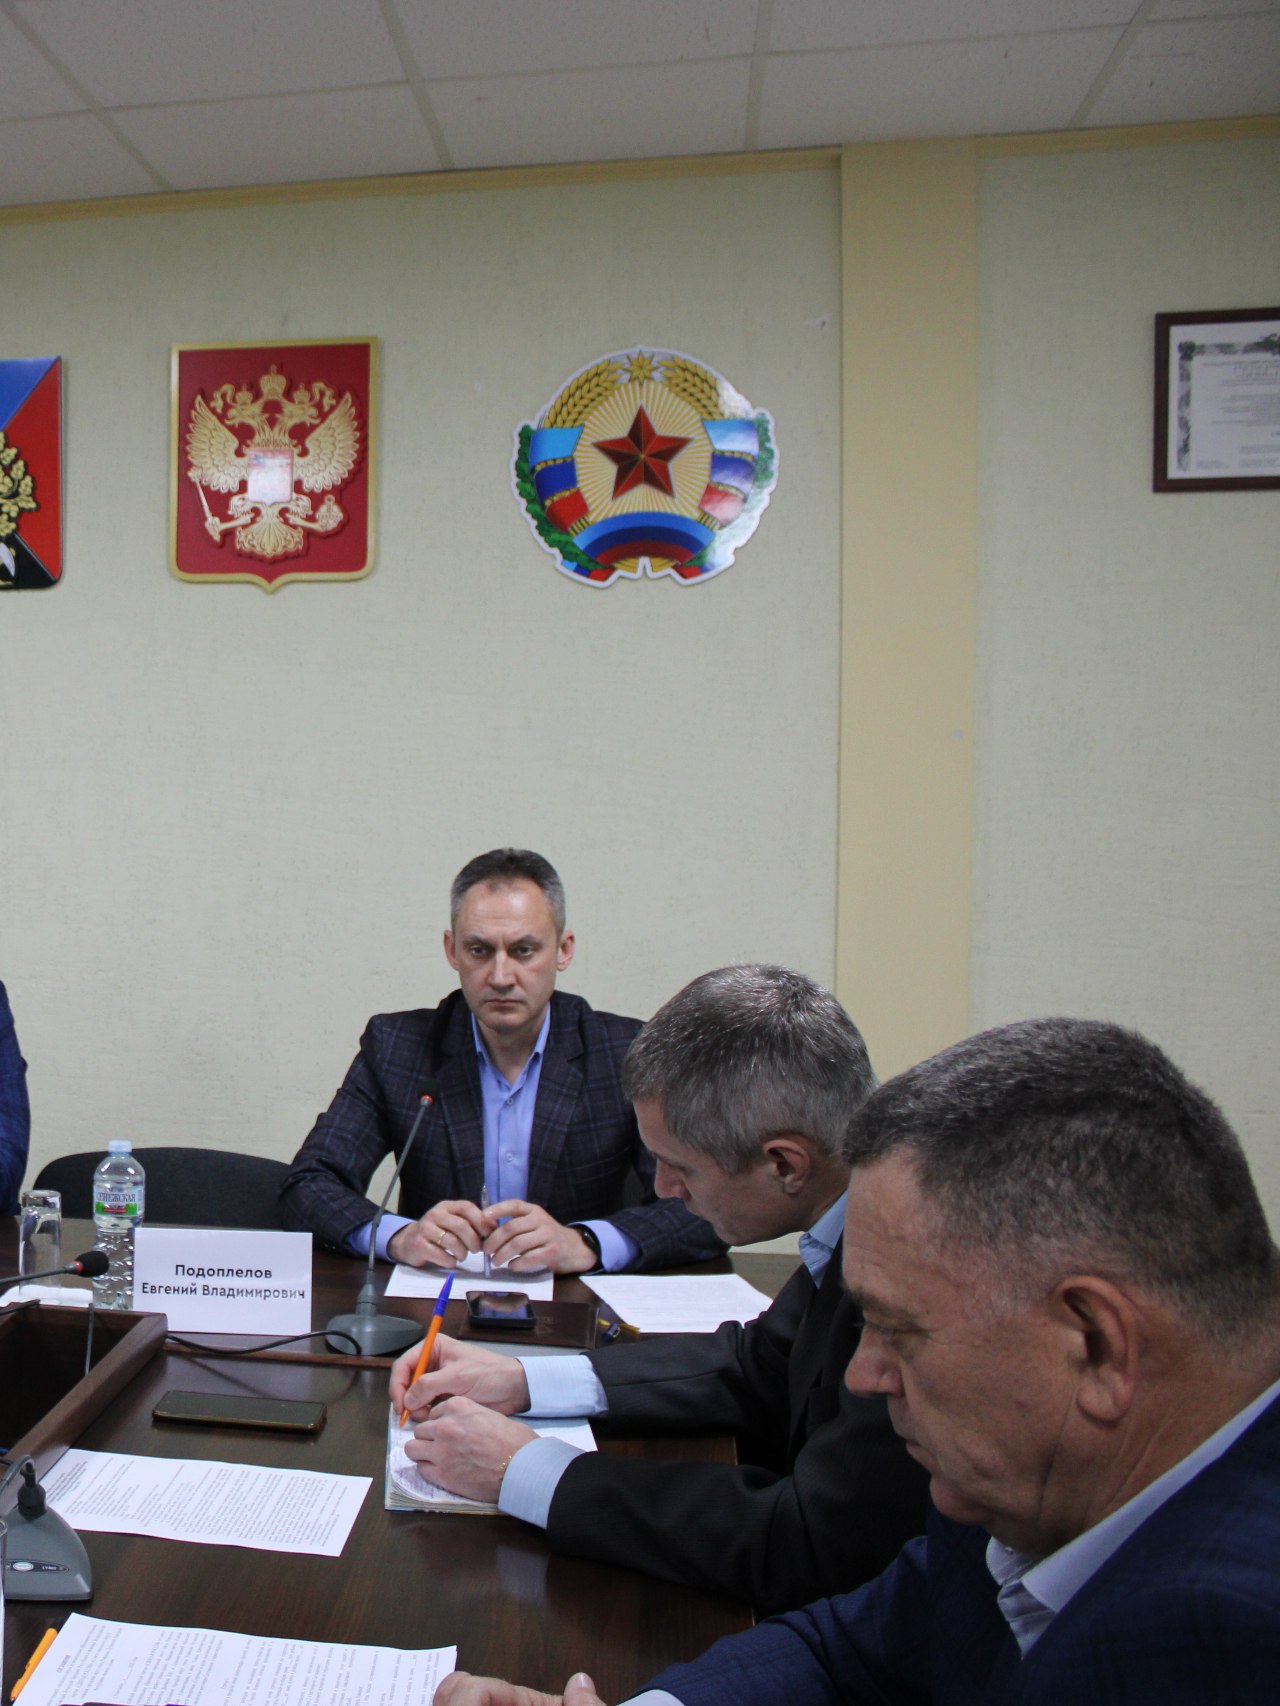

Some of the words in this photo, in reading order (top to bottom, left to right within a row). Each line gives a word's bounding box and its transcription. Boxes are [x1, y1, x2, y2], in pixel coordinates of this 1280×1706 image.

[175, 1264, 272, 1279] Подоплелов
[141, 1282, 197, 1296] Евгений
[202, 1284, 305, 1300] Владимирович
